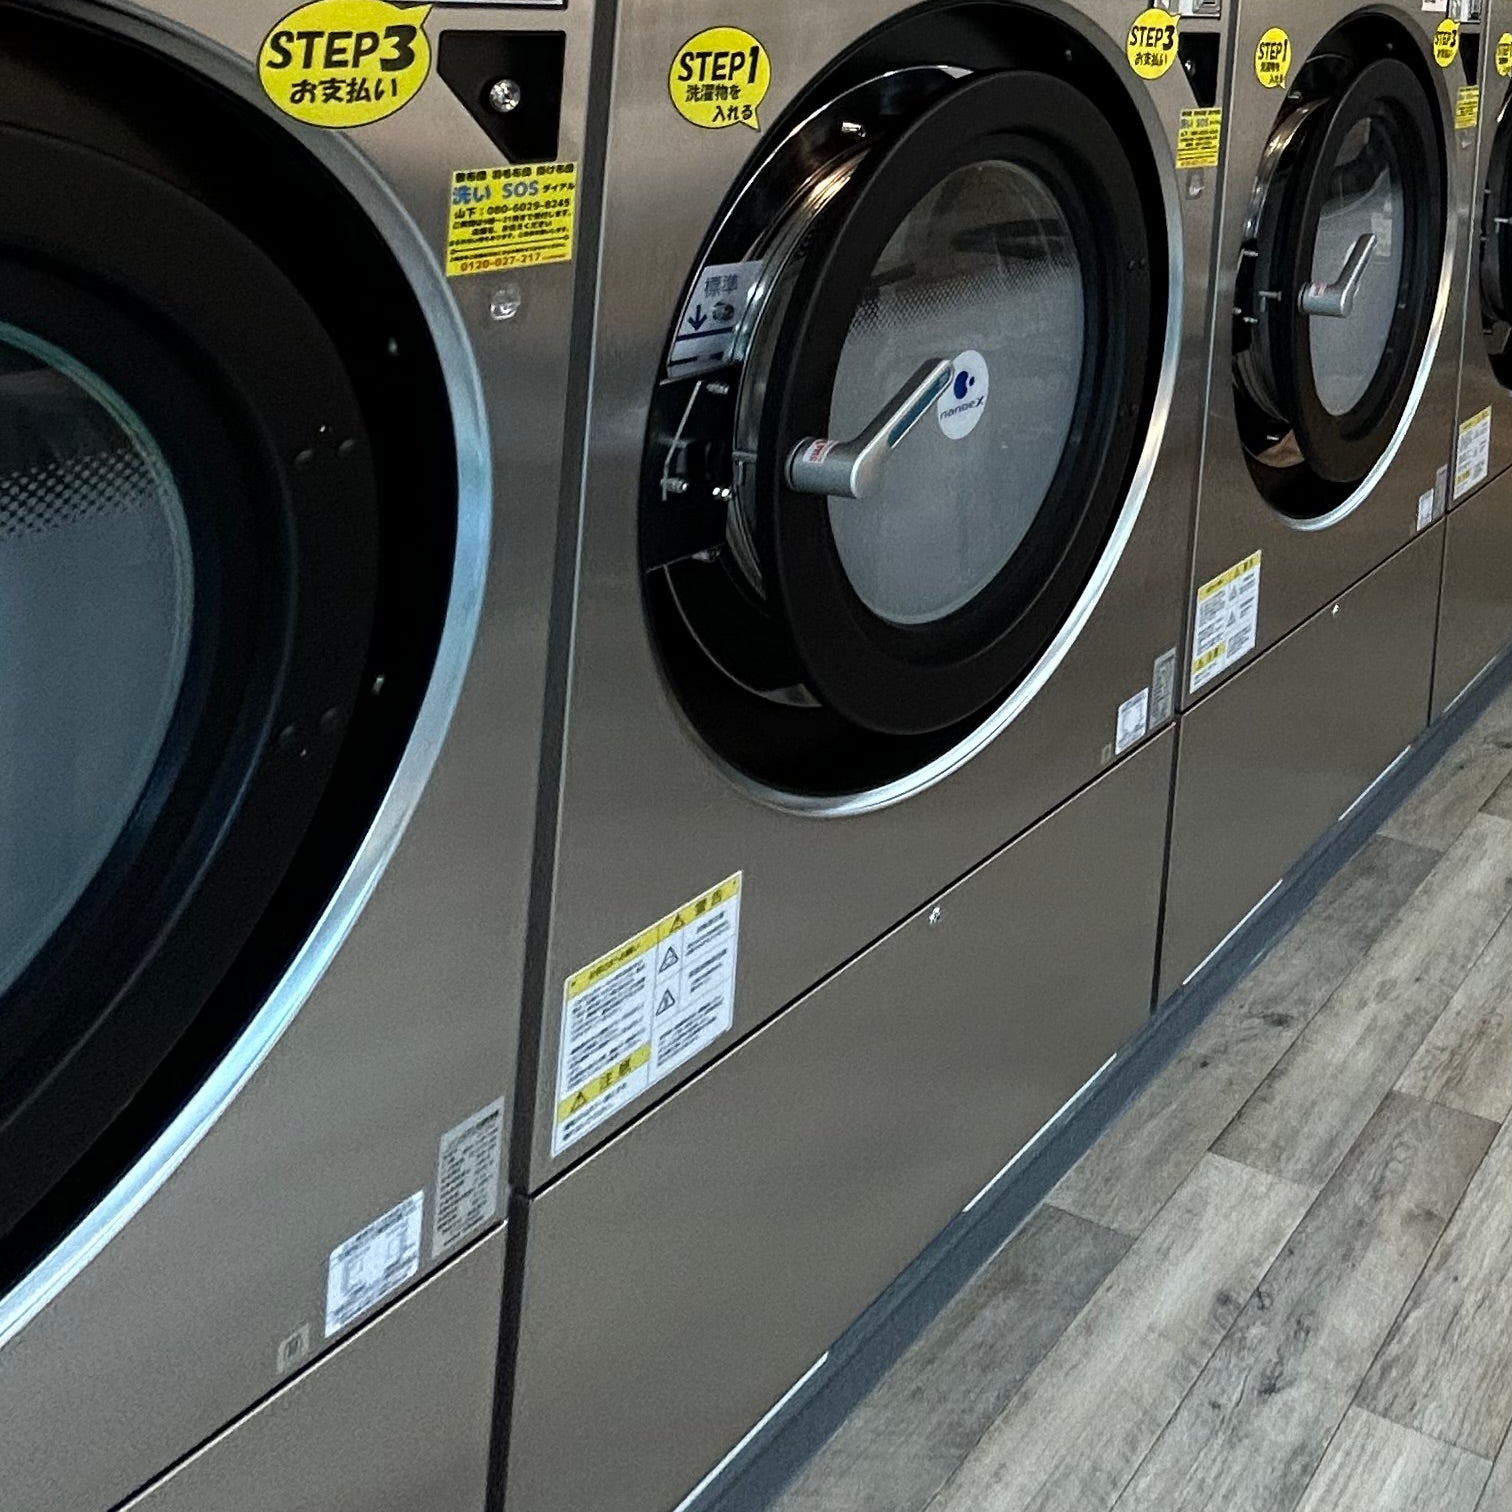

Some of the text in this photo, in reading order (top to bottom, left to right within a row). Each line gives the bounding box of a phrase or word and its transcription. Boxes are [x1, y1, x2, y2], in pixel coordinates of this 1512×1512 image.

[267, 24, 416, 73] STEP3
[1129, 25, 1175, 51] STEP3
[1258, 39, 1288, 62] STEP1
[678, 45, 760, 84] STEP1
[290, 79, 399, 104] お支払い
[685, 84, 741, 102] 洗濯物を
[712, 105, 752, 123] 入れる
[502, 180, 539, 199] SOS
